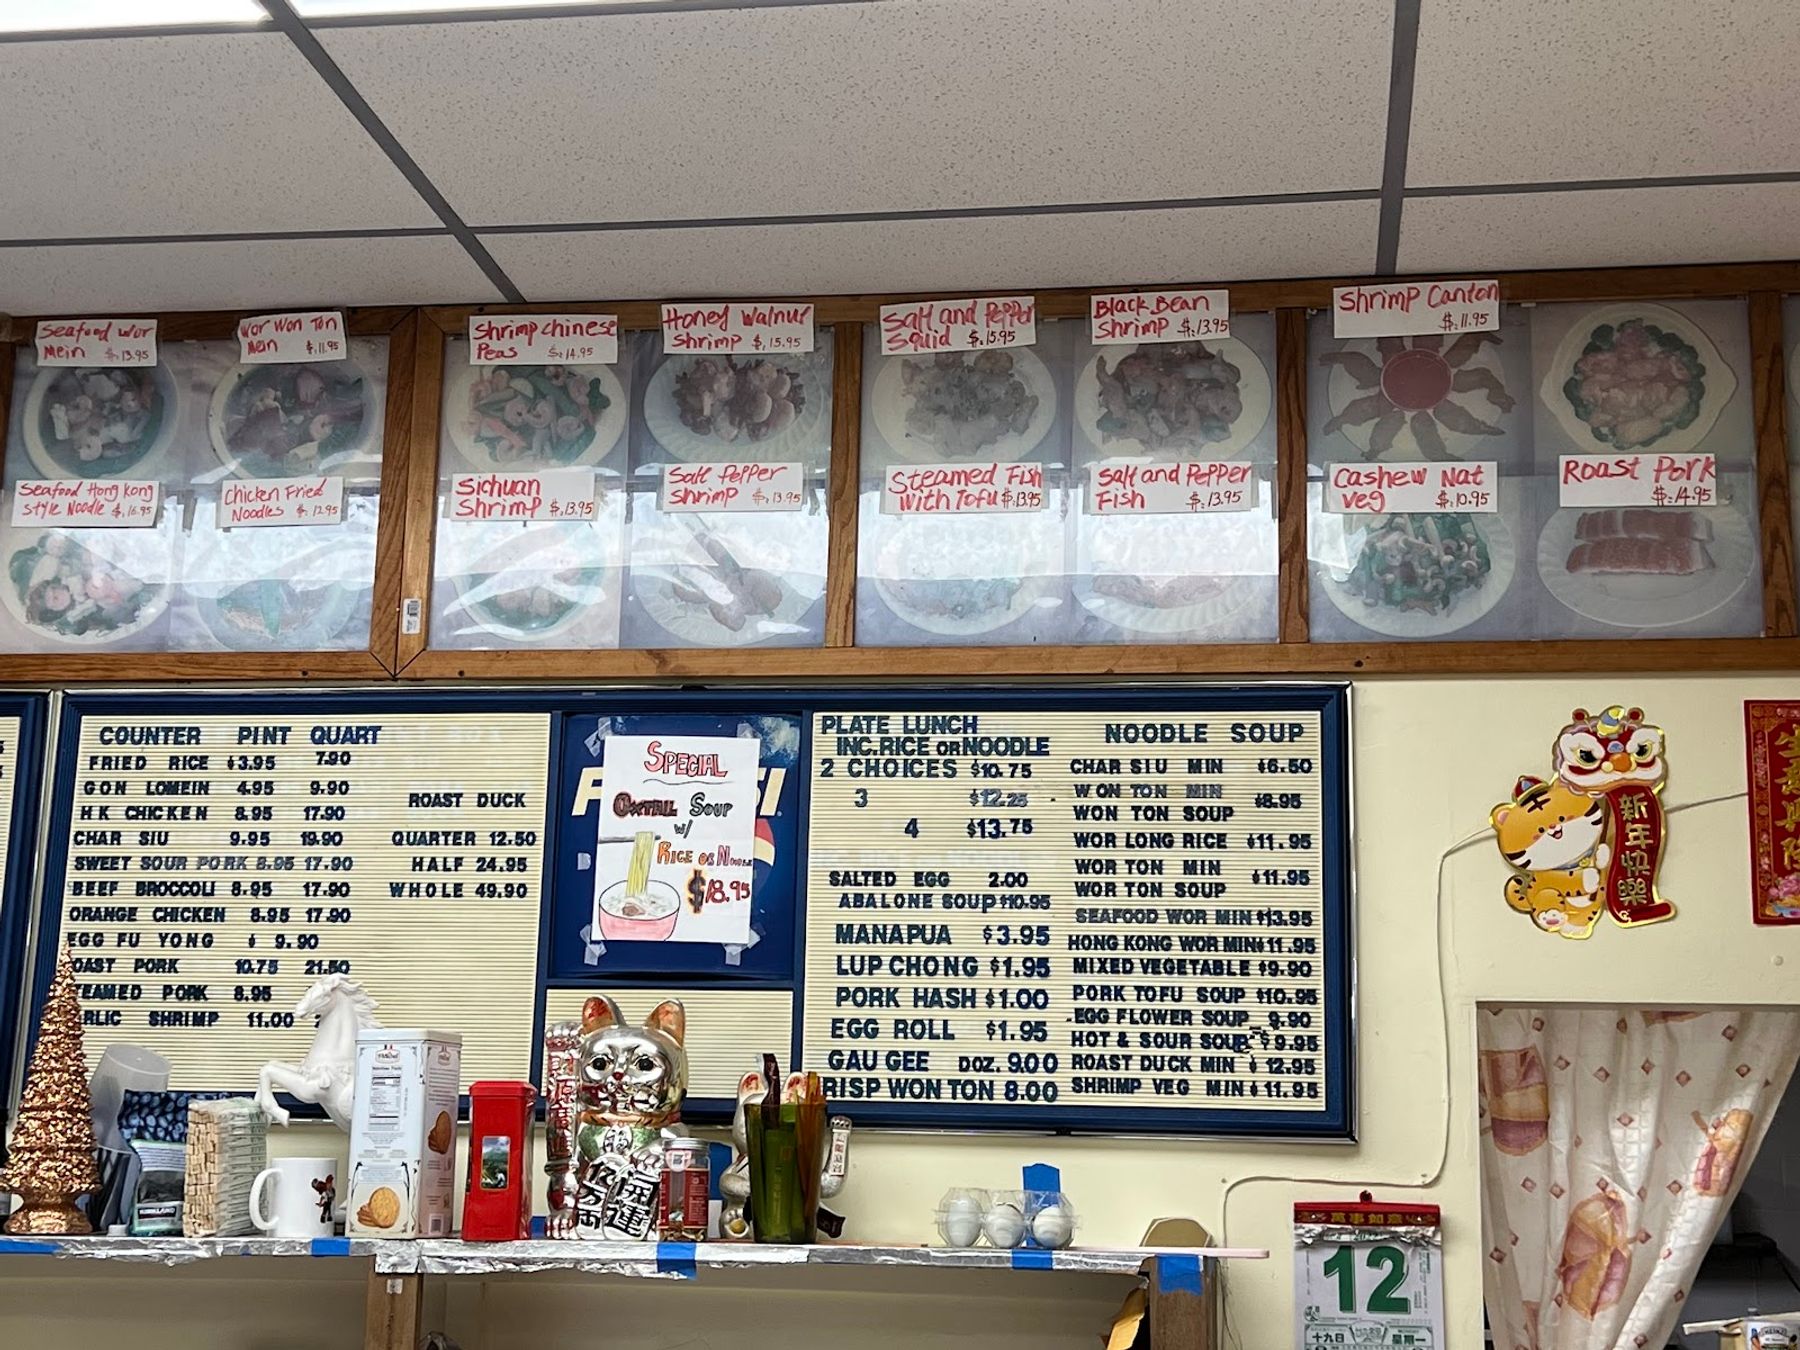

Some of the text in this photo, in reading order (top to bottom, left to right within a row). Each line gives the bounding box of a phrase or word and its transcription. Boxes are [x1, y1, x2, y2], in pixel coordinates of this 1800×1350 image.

[1427, 282, 1499, 309] Canton
[939, 299, 978, 326] and
[1093, 295, 1210, 319] Black Bean
[241, 316, 337, 337] Wor Won Ton
[663, 304, 730, 331] Honey
[39, 322, 112, 343] Seafood
[477, 343, 518, 360] Peas
[888, 462, 1042, 494] Steamed Fish
[1141, 463, 1180, 485] and
[1334, 465, 1485, 490] Cashew Nat
[1563, 455, 1716, 485] Roast Pork
[18, 481, 118, 502] Seafood Hong
[285, 478, 327, 499] Fried
[67, 499, 105, 516] Noodle
[956, 488, 998, 510] Tofu
[1096, 488, 1145, 511] Fish
[232, 504, 284, 522] Noodles
[821, 715, 978, 734] PLATE LUNCH
[1105, 723, 1304, 744] NOODLE SOUP
[100, 725, 382, 745] COUNTER PINT QUART
[89, 751, 351, 770] FRIED RICE 7.90
[820, 759, 958, 778] 2 CHOICES
[1070, 758, 1223, 774] CHAR SIU MIN
[83, 781, 349, 795] GON LOMEIN 4.95 9.90
[1073, 784, 1223, 799] WON TON MIN
[409, 793, 526, 807] ROAST DUCK
[125, 806, 345, 821] CHICKEN 8.95 17.90
[1072, 805, 1235, 822] WON TON SOUP
[904, 818, 1033, 839] 4 $13.75
[73, 831, 270, 846] CHAR SIU 9.95
[392, 831, 536, 846] QUARTER 12.50
[1073, 832, 1227, 849] WOR LONG RICE
[1617, 793, 1653, 907] 新年快樂
[74, 856, 353, 871] SWEET SOUR PORK 17.90
[412, 857, 528, 872] HALF 24.95
[1074, 859, 1222, 875] WOR TON MIN
[829, 871, 1029, 888] SALTED EGG 2.00
[72, 881, 350, 897] BEEF BROCCOLI 8.95 17.90
[389, 883, 528, 898] WHOLE 49.90
[1074, 882, 1227, 898] WOR TON SOUP
[838, 893, 934, 909] ABALONE
[70, 906, 351, 923] ORANGE CHICKEN 8.95 17.90
[1075, 908, 1252, 925] SEAFOOD WOR MIN
[117, 932, 213, 948] FU YONG
[835, 924, 952, 945] MANAPUA
[1067, 935, 1172, 951] HONG KONG
[134, 958, 181, 973] PORK
[836, 955, 1051, 978] LUP CHONG $1.95
[1073, 957, 1250, 976] MIXED VEGETABLE
[162, 985, 209, 1000] PORK
[836, 987, 1049, 1010] PORK HASH $1.00
[1072, 985, 1246, 1003] PORK TOFU SOUP
[149, 1011, 294, 1028] SHRIMP 11.00
[1074, 1008, 1250, 1026] EGG FLOWER SOUP
[831, 1018, 1048, 1042] EGG ROLL $1.95
[1071, 1031, 1193, 1049] HOT & SOUR
[828, 1050, 1059, 1074] GAU GEE 9.00
[1071, 1054, 1235, 1073] ROAST DUCK MIN
[888, 1078, 1058, 1102] WON TON 8.00
[1071, 1077, 1244, 1097] SHRIMP VEG MIN
[1324, 1245, 1411, 1315] 12
[1312, 1332, 1345, 1343] 十九日
